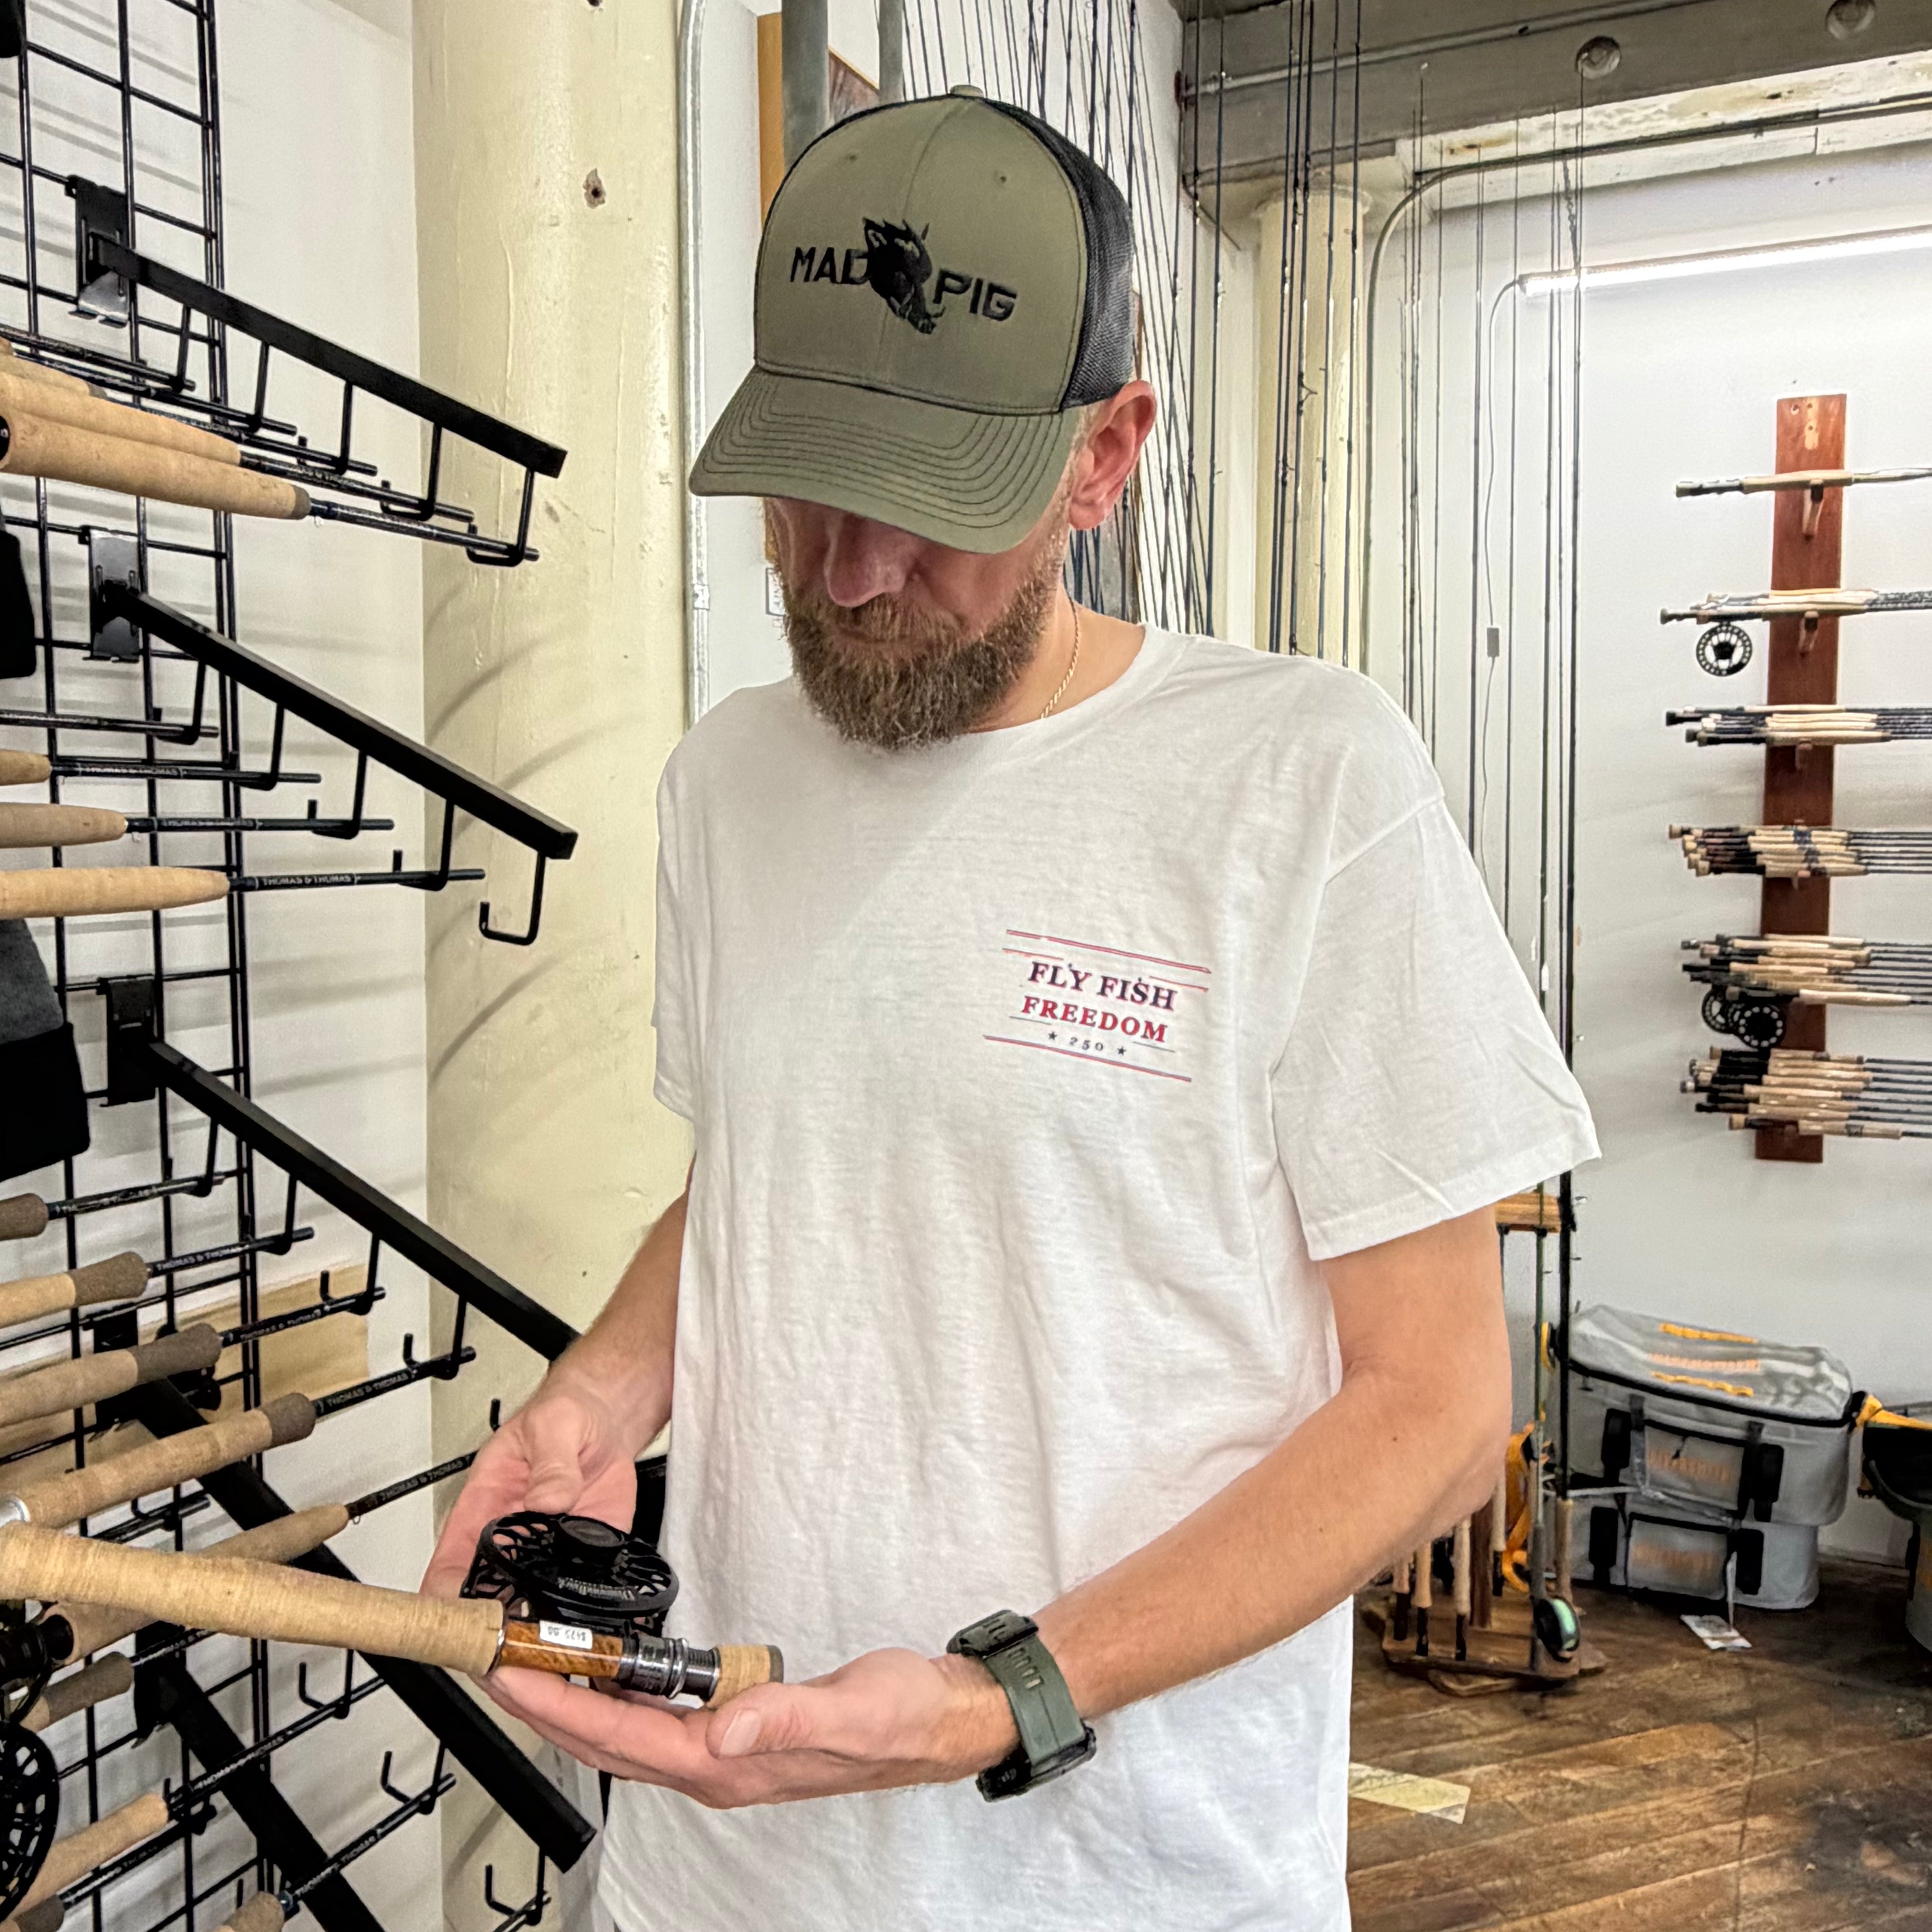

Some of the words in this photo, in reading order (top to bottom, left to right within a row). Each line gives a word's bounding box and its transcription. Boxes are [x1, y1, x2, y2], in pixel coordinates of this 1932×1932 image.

[790, 247, 869, 285] MAD
[933, 269, 1017, 322] PIG
[1028, 961, 1092, 991] FLY
[1096, 975, 1178, 1012] FISH
[1021, 996, 1168, 1043] FREEDOM
[1069, 1036, 1104, 1051] 250
